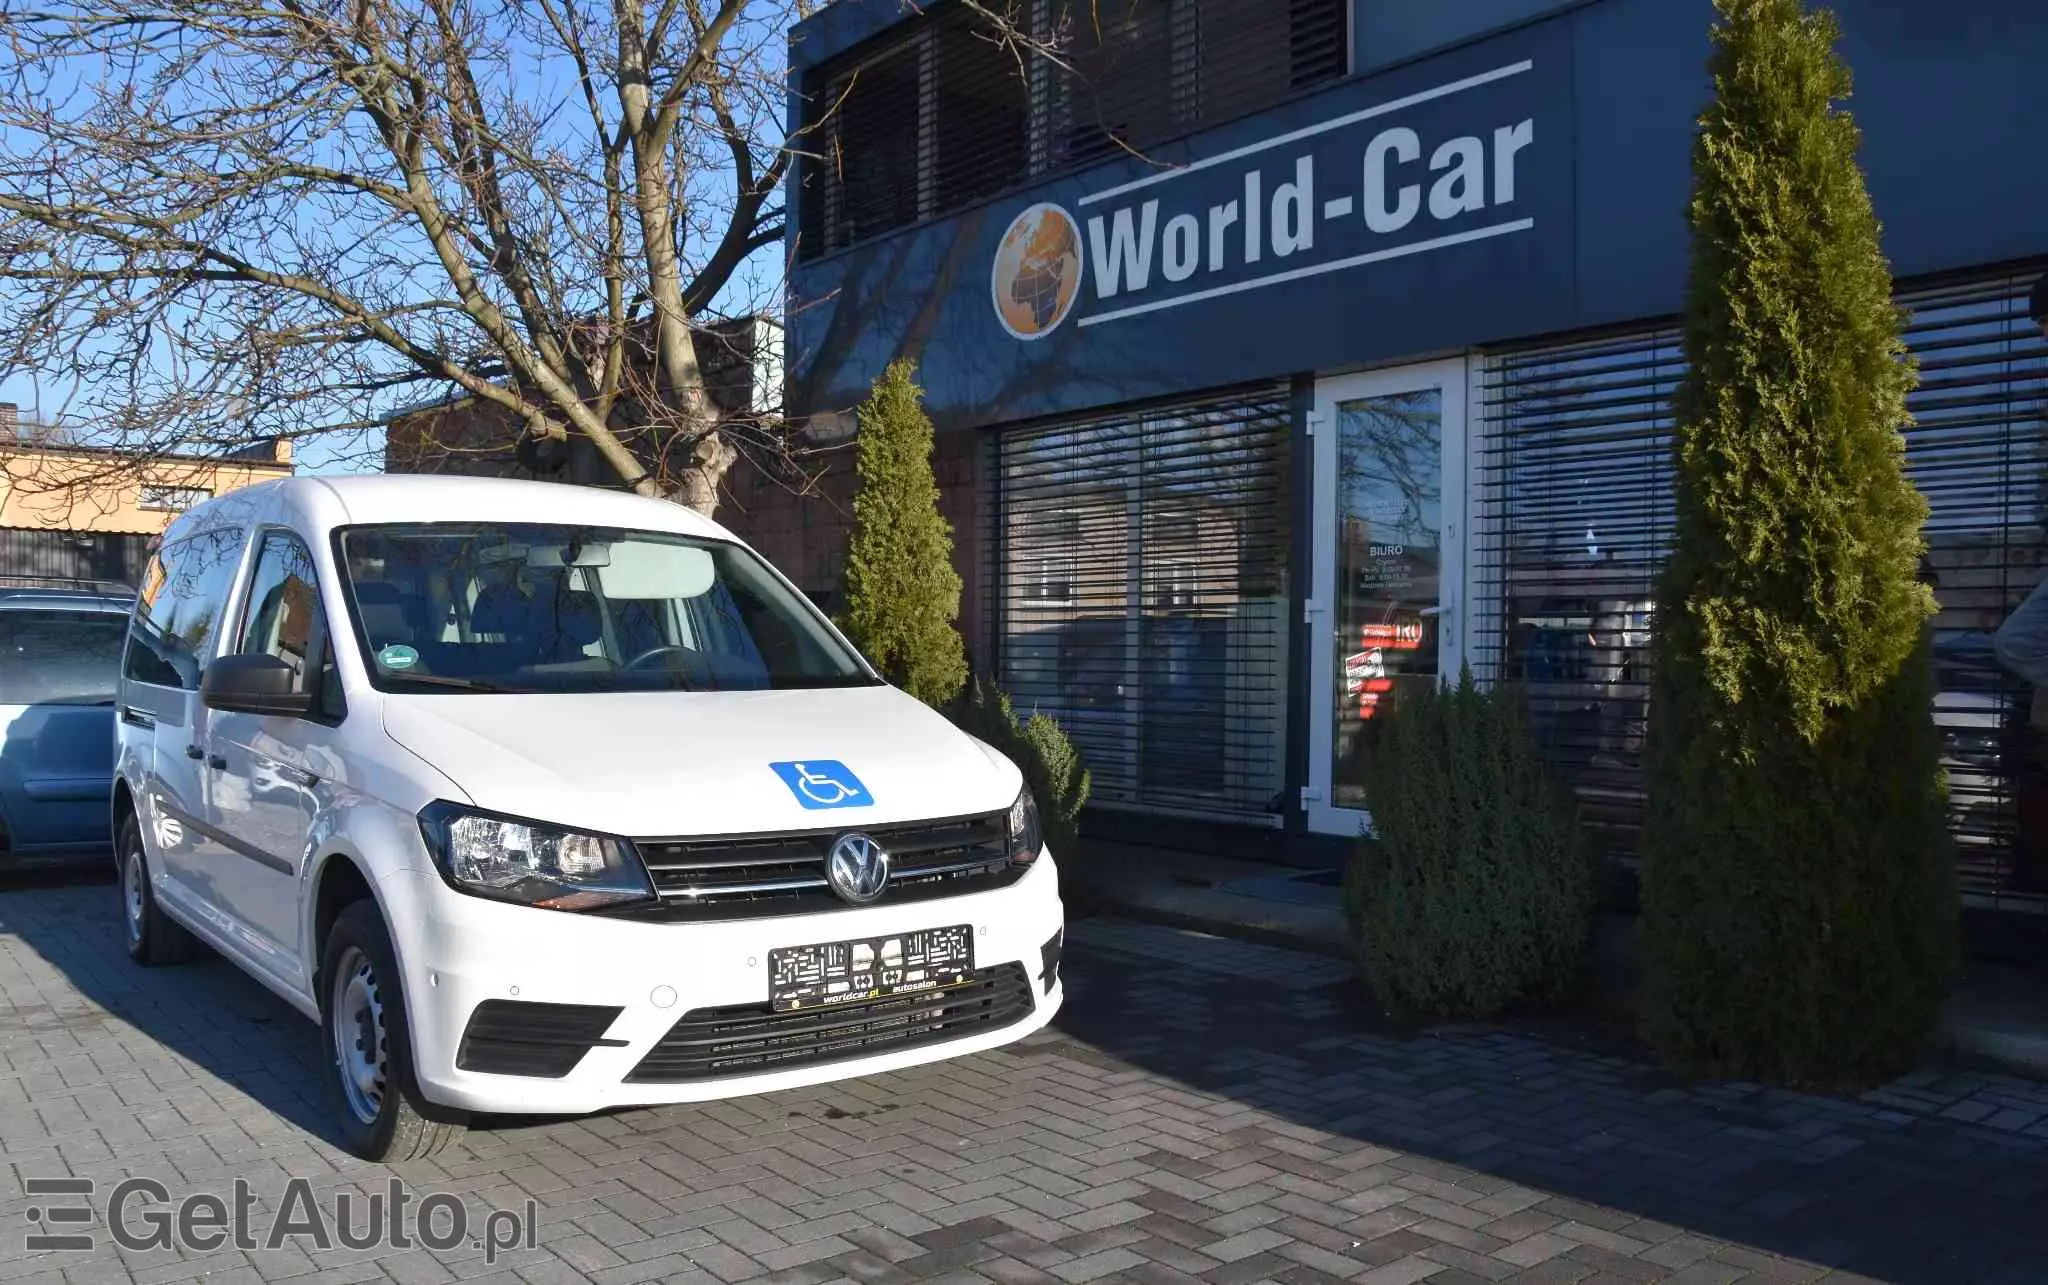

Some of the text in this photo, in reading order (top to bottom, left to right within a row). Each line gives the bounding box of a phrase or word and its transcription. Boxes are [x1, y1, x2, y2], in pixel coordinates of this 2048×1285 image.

[1088, 118, 1533, 299] World-Car
[1369, 545, 1403, 556] BIURO
[823, 980, 937, 1004] worldcar.pl autosalon
